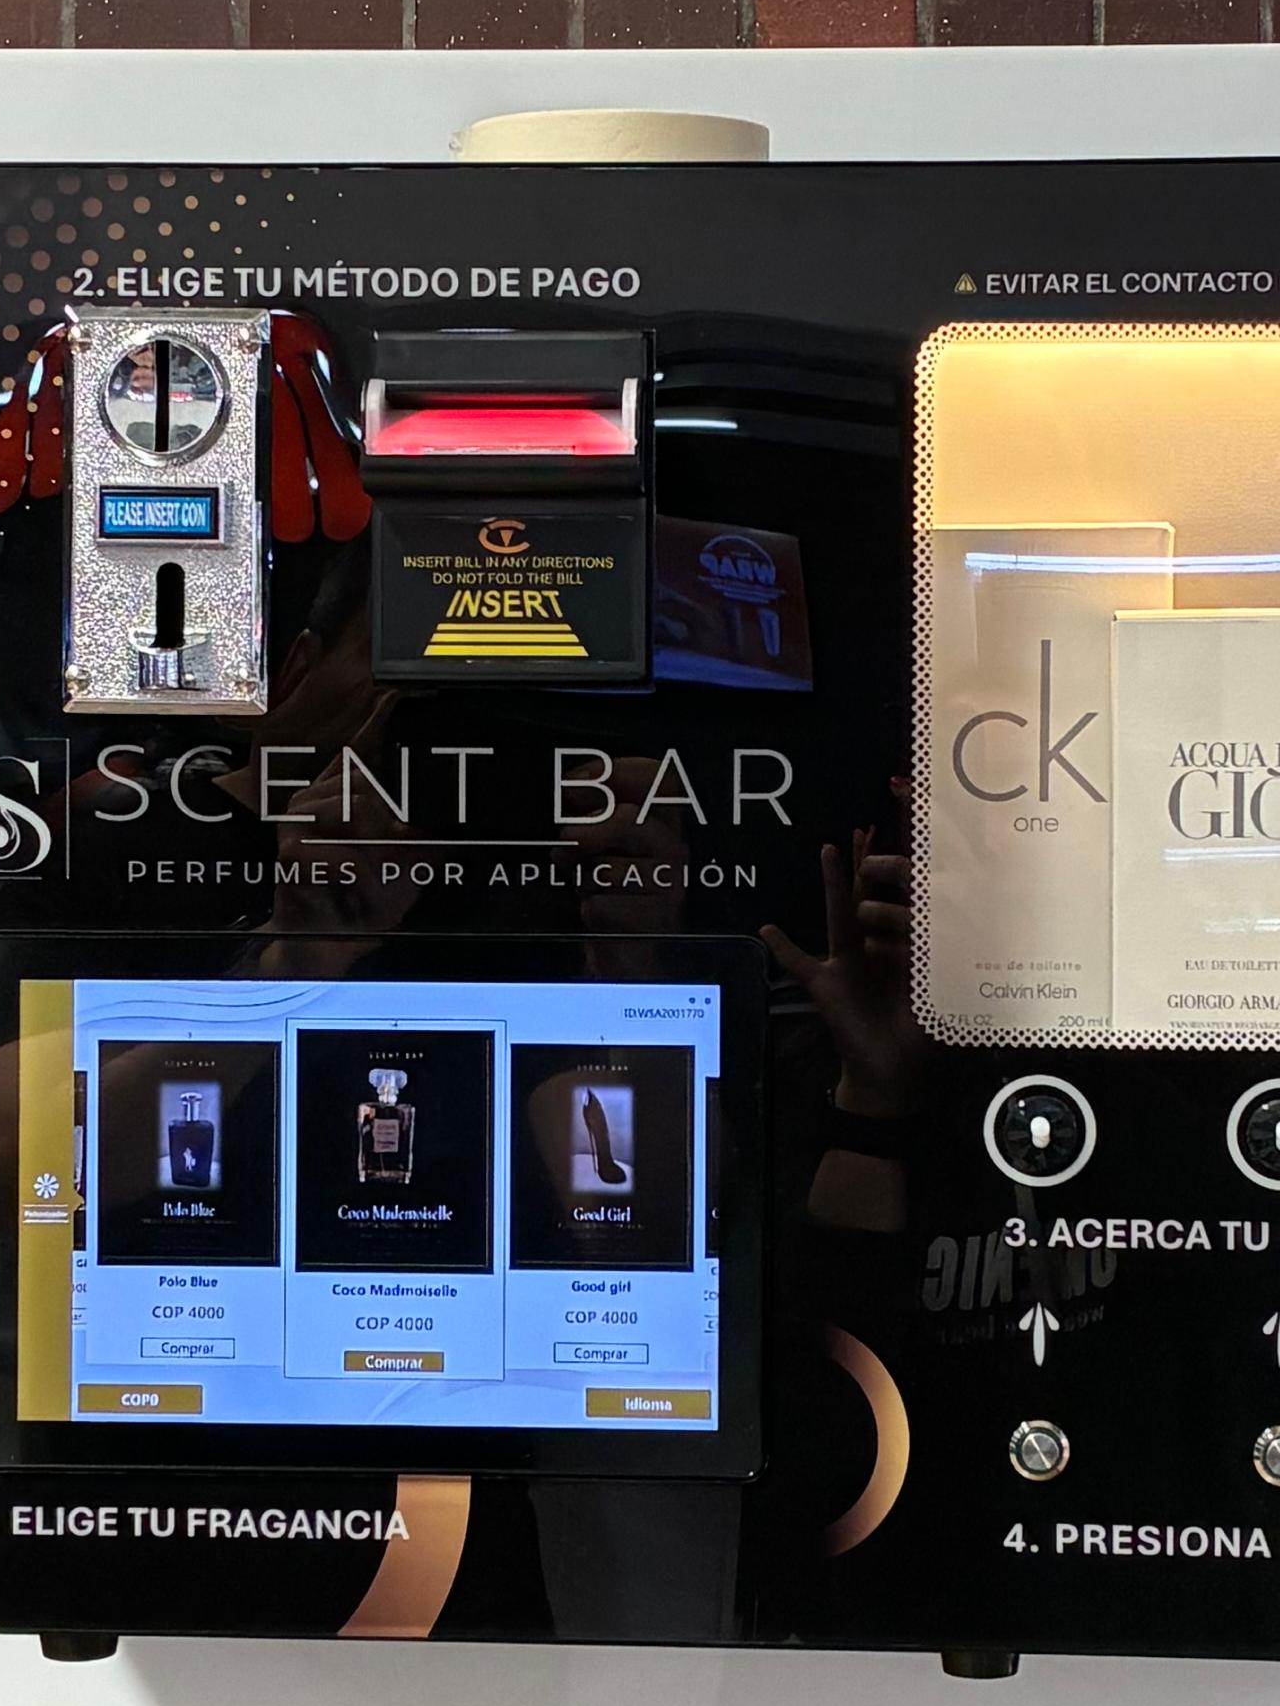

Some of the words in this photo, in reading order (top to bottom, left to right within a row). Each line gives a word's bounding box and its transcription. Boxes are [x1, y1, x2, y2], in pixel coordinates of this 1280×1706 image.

[72, 269, 106, 297] 2.
[120, 267, 224, 297] ELIGE
[234, 267, 282, 297] TU
[294, 260, 460, 297] MÉTODO
[470, 267, 522, 297] DE
[532, 267, 640, 297] PAGO
[986, 273, 1080, 293] EVITAR
[1086, 273, 1116, 293] EL
[1122, 271, 1273, 293] CONTACTO
[104, 501, 144, 526] PLEASE
[403, 556, 452, 569] INSERT
[454, 556, 482, 569] BILL
[486, 556, 499, 569] IN
[502, 556, 528, 569] ANY
[532, 556, 614, 569] DIRECTIONS
[432, 573, 453, 585] DO
[456, 573, 484, 585] NOT
[488, 573, 523, 585] FOLD
[526, 573, 552, 585] THE
[556, 573, 584, 585] BILL
[446, 589, 564, 619] INSERT
[952, 639, 1108, 803] ck
[1170, 742, 1267, 771] ACQUA
[95, 745, 494, 825] SCENT
[554, 747, 794, 827] BAR
[1013, 813, 1060, 833] one
[126, 860, 358, 885] PERFUMES
[382, 862, 464, 887] POR
[489, 857, 758, 889] APLICACIÓN
[979, 981, 1034, 999] Calvin
[1036, 983, 1078, 999] Klein
[1167, 994, 1235, 1010] GIORGIO
[1004, 1219, 1038, 1249] 3.
[1048, 1219, 1211, 1252] ACERCA
[1220, 1221, 1270, 1253] TU
[159, 1276, 186, 1287] Polo
[190, 1276, 218, 1287] Blue
[332, 1284, 366, 1295] Coco
[572, 1281, 606, 1293] Good
[610, 1281, 632, 1295] girl
[152, 1305, 184, 1319] COP
[188, 1306, 224, 1319] 4000
[565, 1311, 596, 1323] COP
[601, 1311, 638, 1324] 4000
[356, 1317, 390, 1329] COP
[394, 1317, 434, 1331] 4000
[162, 1342, 214, 1358] Comprar
[574, 1347, 628, 1363] Comprar
[365, 1355, 423, 1371] Comprar
[624, 1397, 672, 1411] Idioma
[12, 1507, 118, 1537] ELIGE
[128, 1507, 174, 1537] TU
[188, 1507, 410, 1539] FRAGANCIA
[1003, 1523, 1038, 1553] 4.
[1055, 1525, 1272, 1559] PRESIONA
